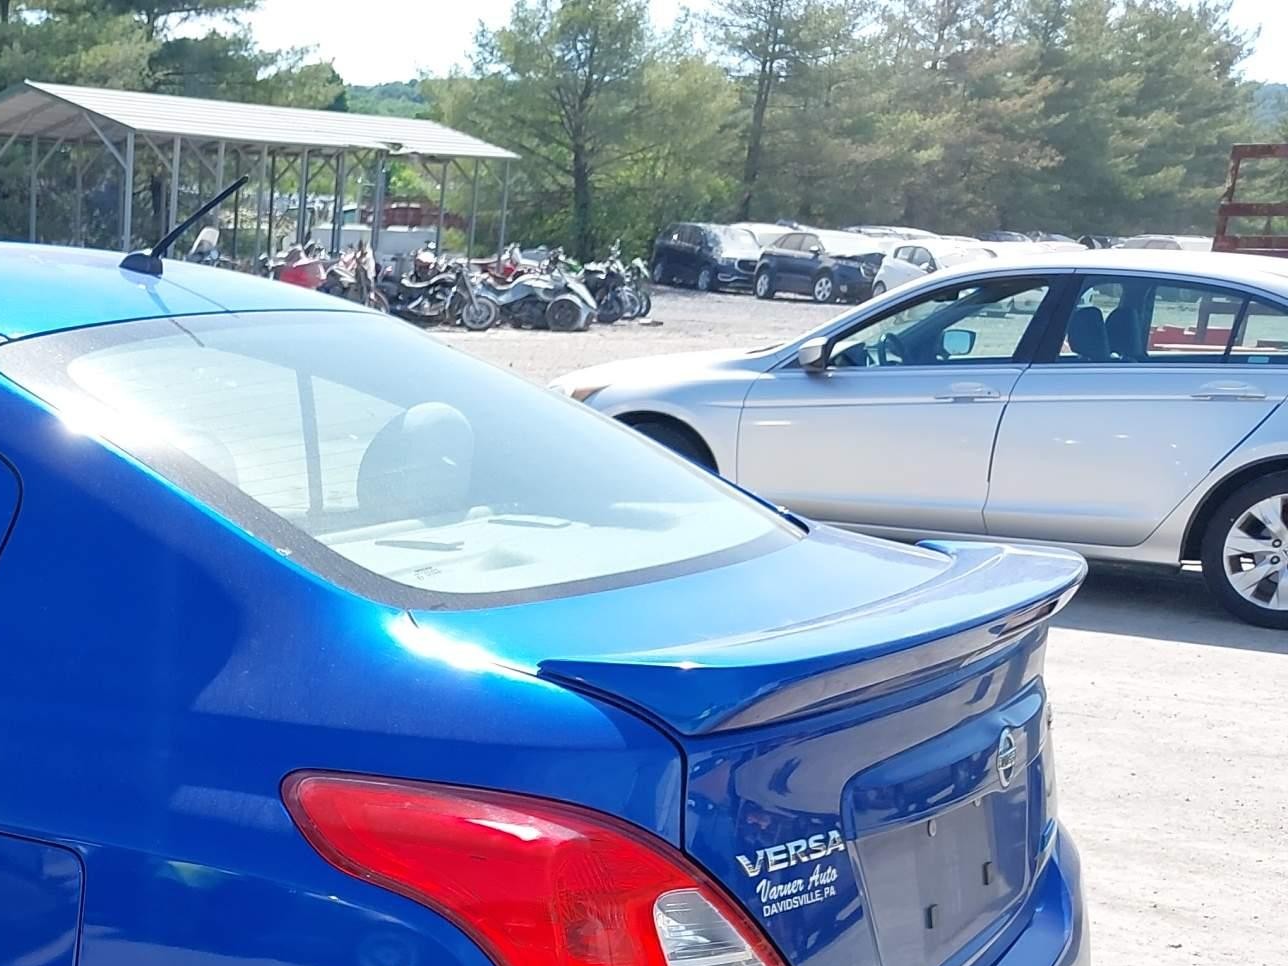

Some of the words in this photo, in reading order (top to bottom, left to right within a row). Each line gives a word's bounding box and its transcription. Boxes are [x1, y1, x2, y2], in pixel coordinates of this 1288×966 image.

[735, 830, 845, 877] VERSA
[756, 879, 805, 903] Varner
[808, 864, 838, 890] Auto
[824, 885, 837, 899] PA
